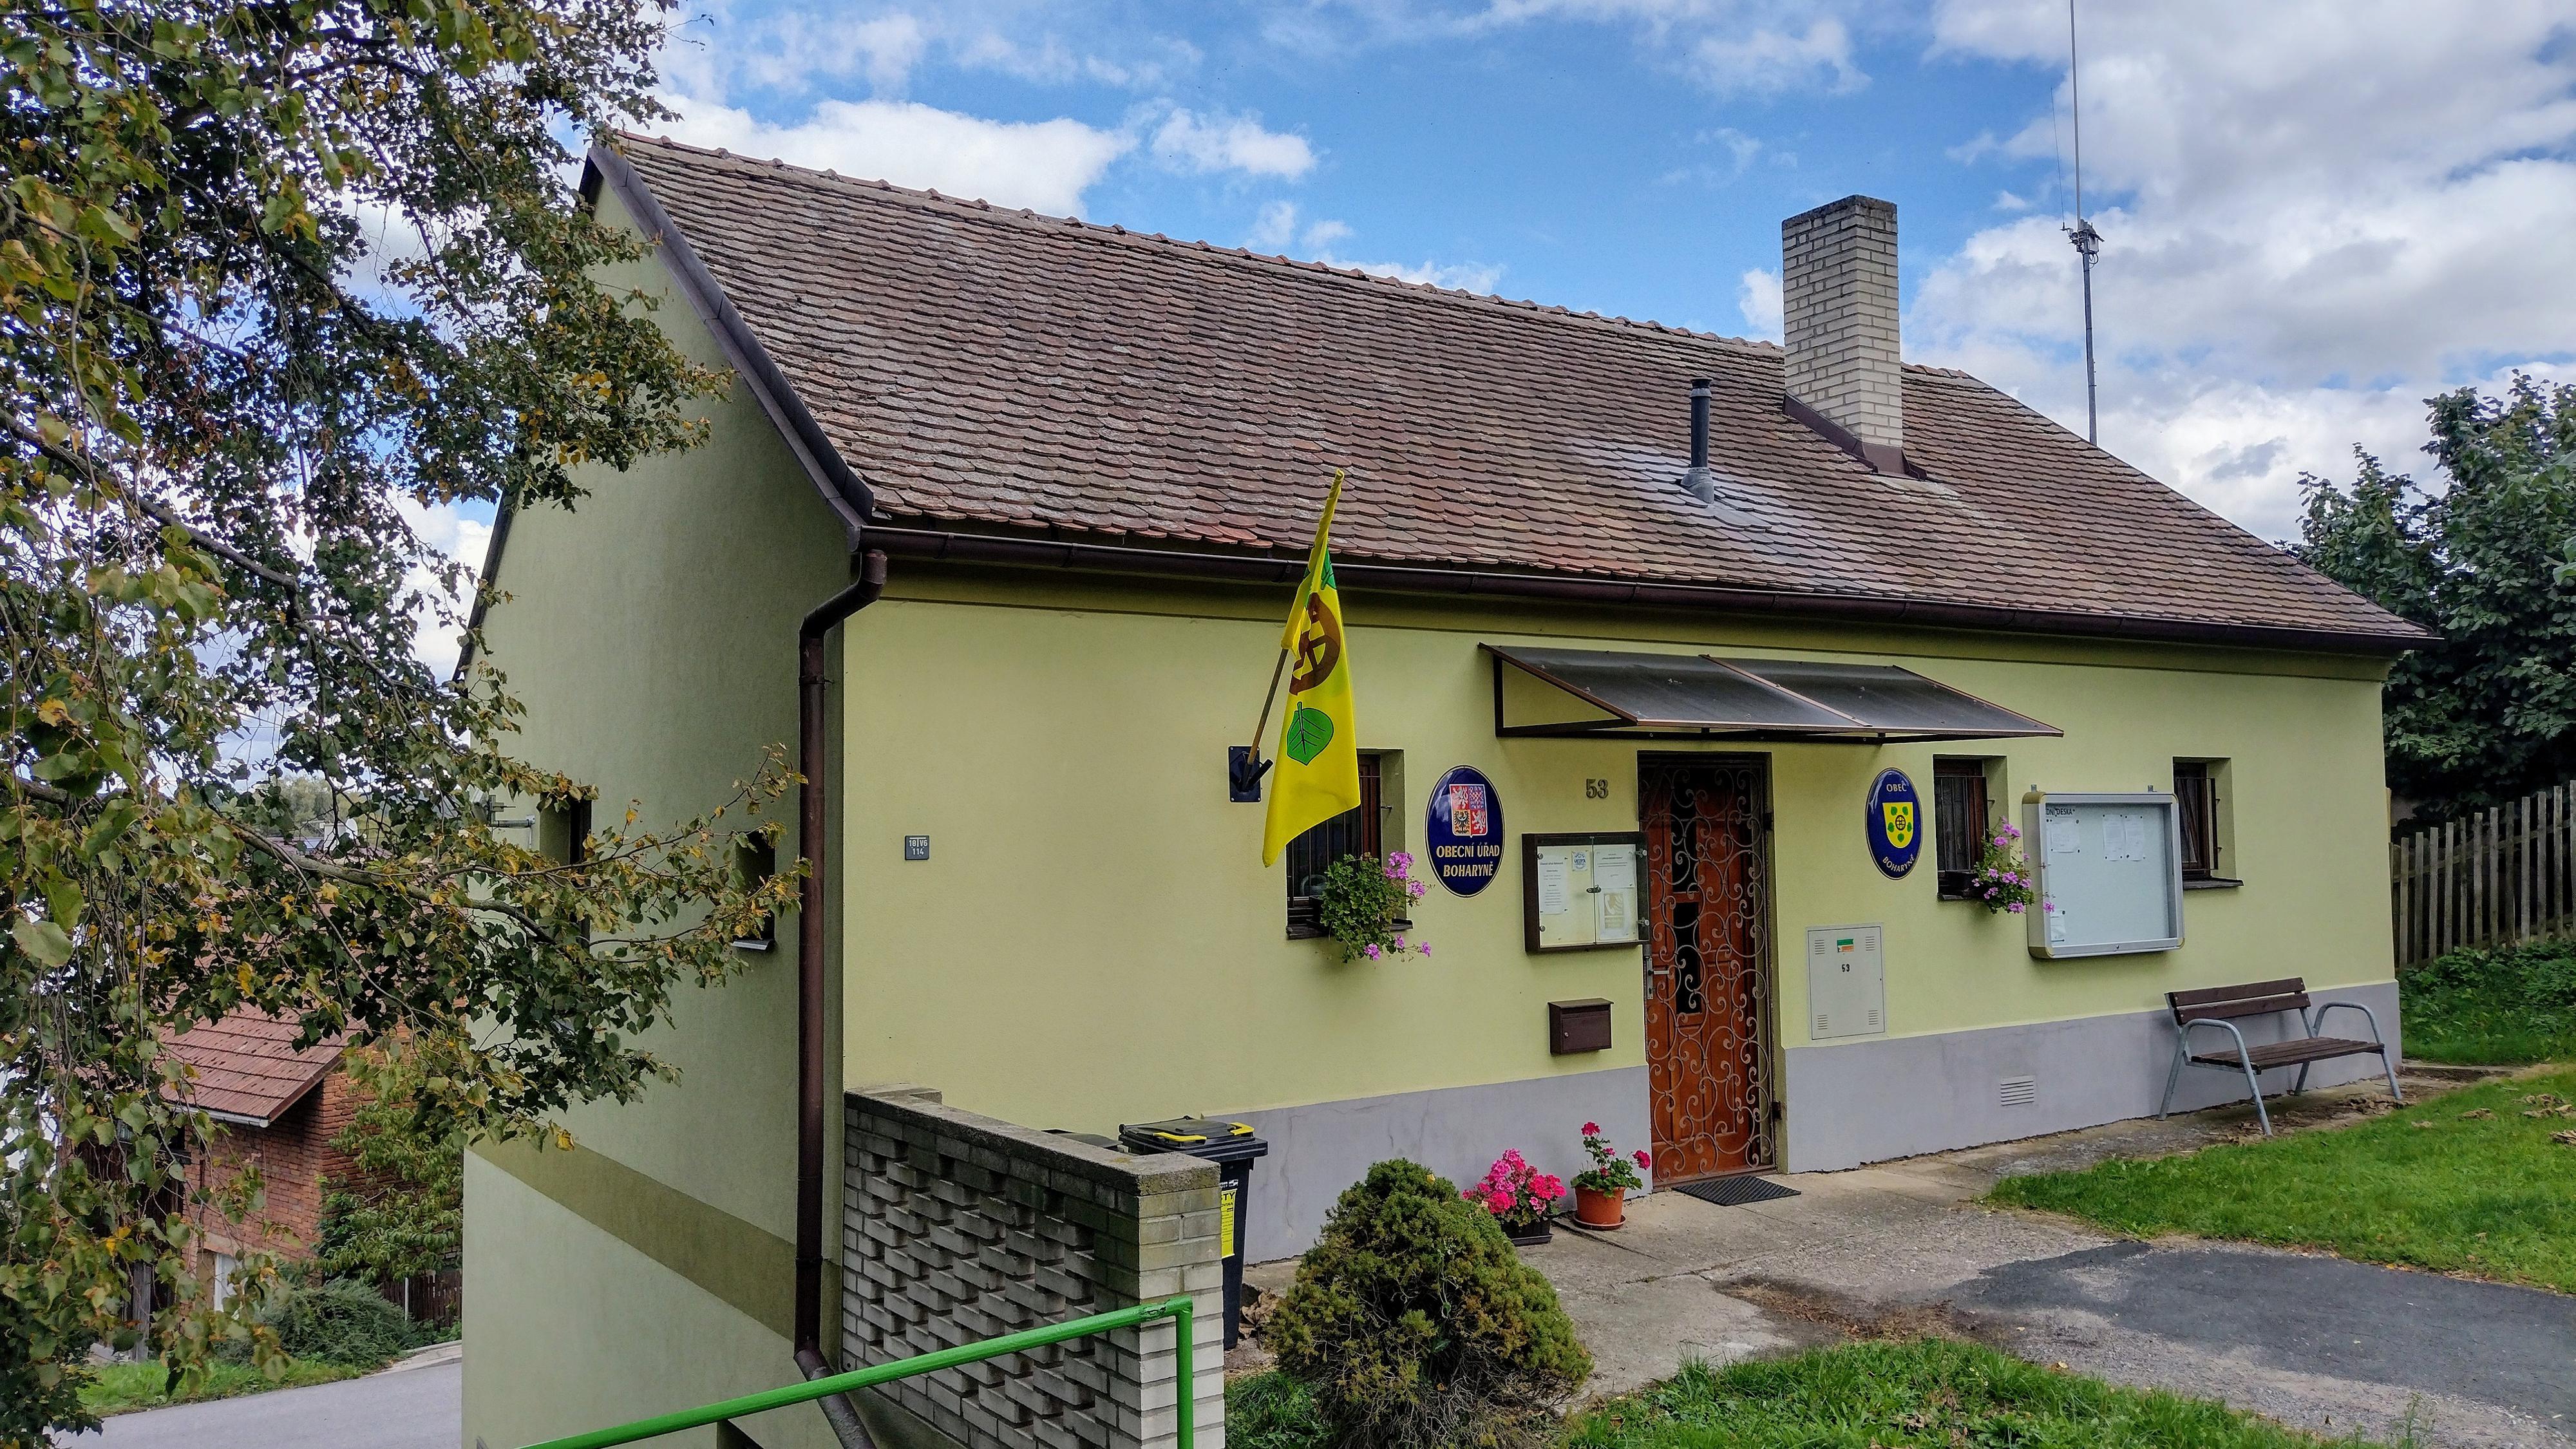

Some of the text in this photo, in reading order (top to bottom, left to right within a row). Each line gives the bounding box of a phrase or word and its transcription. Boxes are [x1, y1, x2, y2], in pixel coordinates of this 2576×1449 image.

[1586, 779, 1609, 799] 53
[1886, 783, 1907, 792] OBEC
[1436, 842, 1500, 858] OBECNÍ ÚŘAD
[1443, 861, 1493, 876] BOHARYNĚ
[1882, 853, 1915, 872] BOHARYNĚ
[1841, 963, 1850, 972] 53
